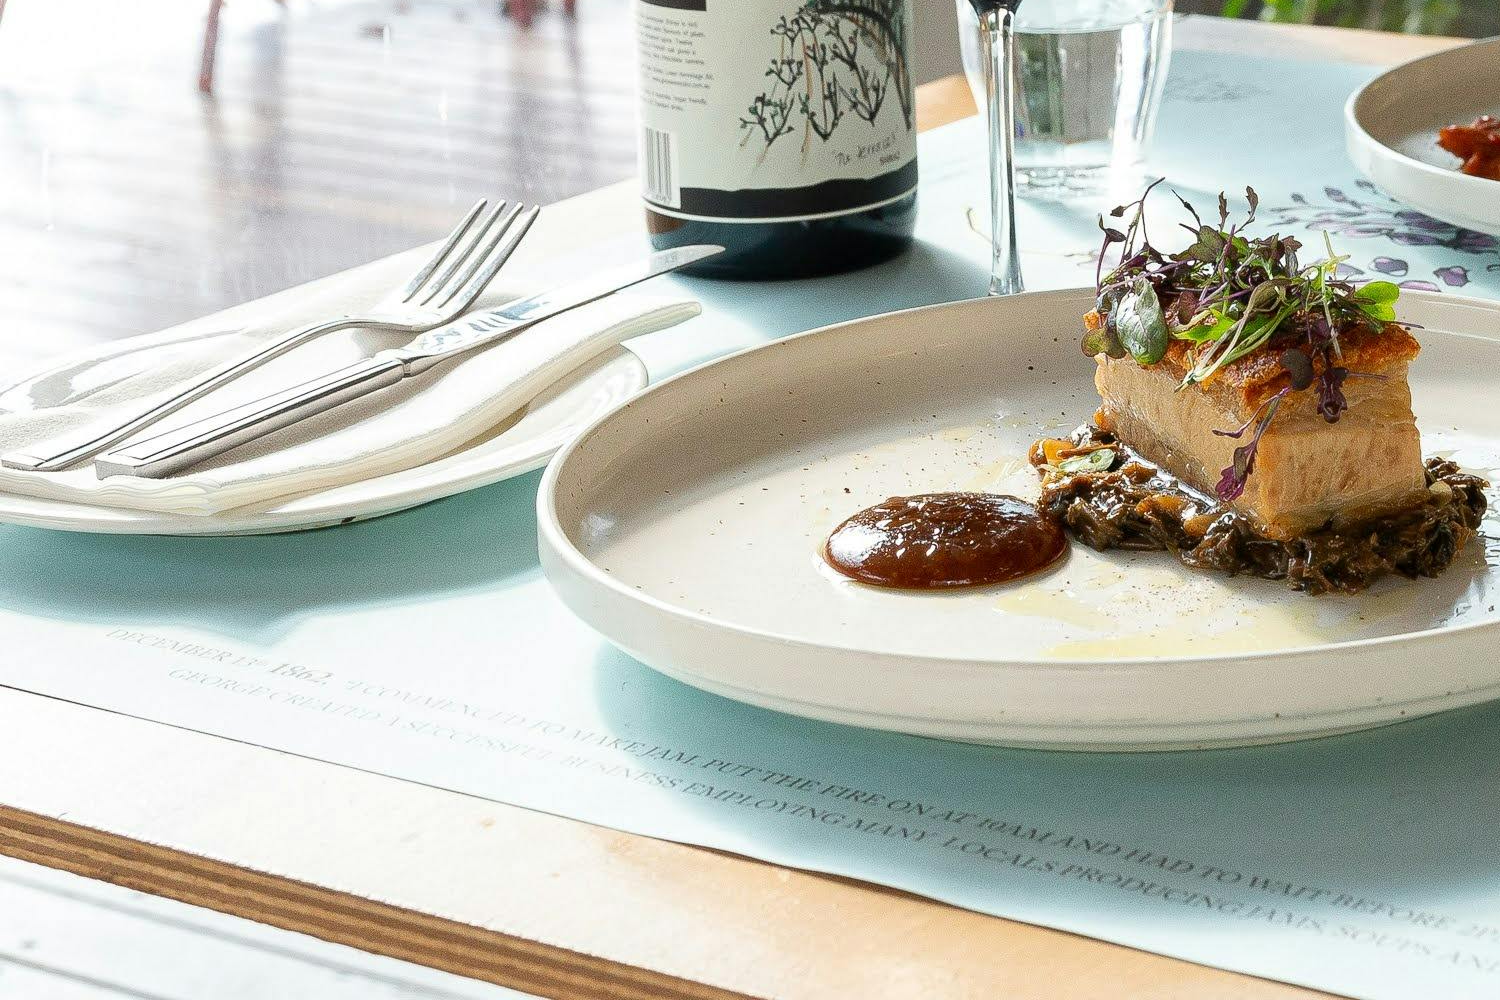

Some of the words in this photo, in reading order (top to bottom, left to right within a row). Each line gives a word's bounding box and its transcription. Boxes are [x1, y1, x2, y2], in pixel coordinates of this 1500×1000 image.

[105, 628, 233, 663] DECEMBER
[572, 729, 646, 754] MAKE
[701, 758, 762, 778] PUT
[757, 770, 821, 792] THE
[818, 784, 887, 807] FIRE
[886, 799, 935, 817] ON
[931, 809, 979, 824] AT
[1050, 835, 1122, 856] AND
[1121, 848, 1195, 873] HAD
[1199, 864, 1242, 884] TO
[1248, 875, 1332, 901] WAIT
[167, 667, 271, 696] GEORGE
[682, 781, 846, 826] EMPLOYING
[847, 817, 939, 842] MANY
[941, 836, 1059, 872] LOCALS
[1059, 864, 1245, 913] PRODUCING
